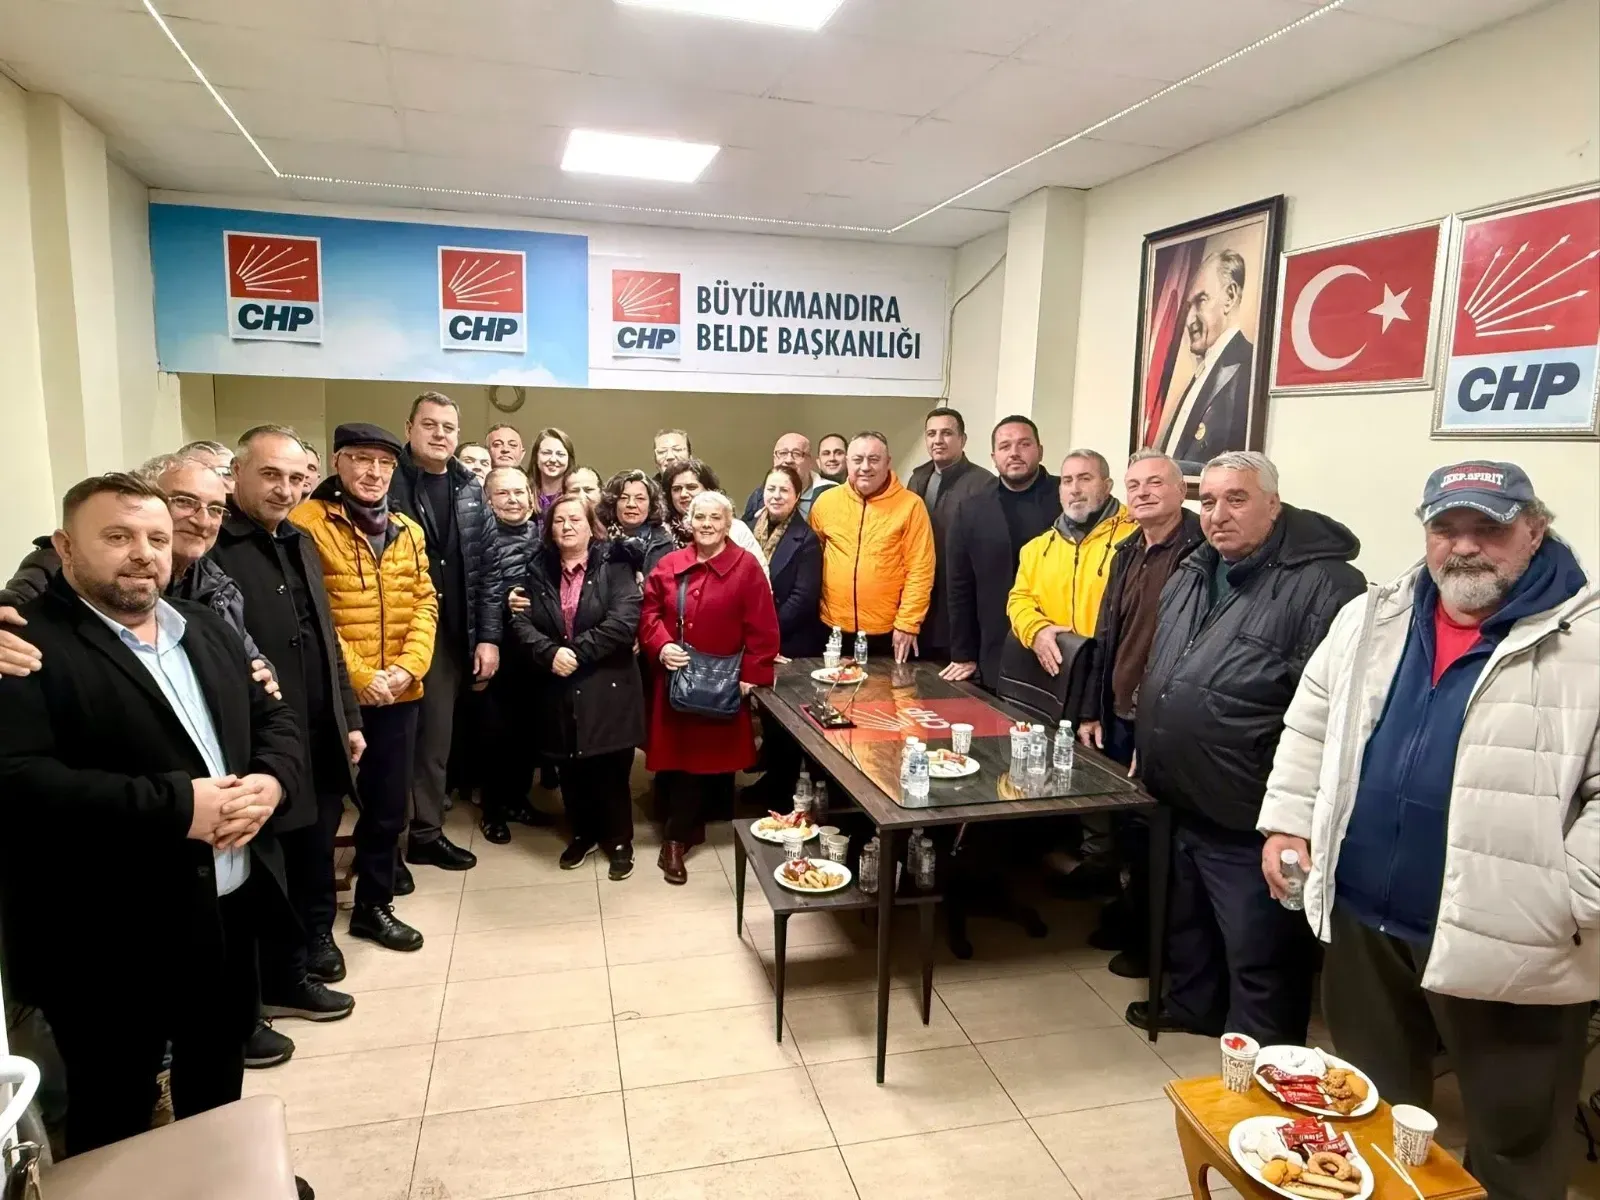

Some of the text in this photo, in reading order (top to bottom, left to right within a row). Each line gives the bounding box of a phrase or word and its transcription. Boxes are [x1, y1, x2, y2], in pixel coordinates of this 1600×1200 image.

[697, 279, 902, 323] BÜYÜKMANDIRA
[237, 303, 314, 332] CHP
[448, 315, 518, 342] CHP
[617, 327, 676, 350] CHP
[697, 323, 921, 360] BELDE BAŞKANLIĞI
[1457, 362, 1581, 413] CHP
[904, 707, 951, 729] CHP
